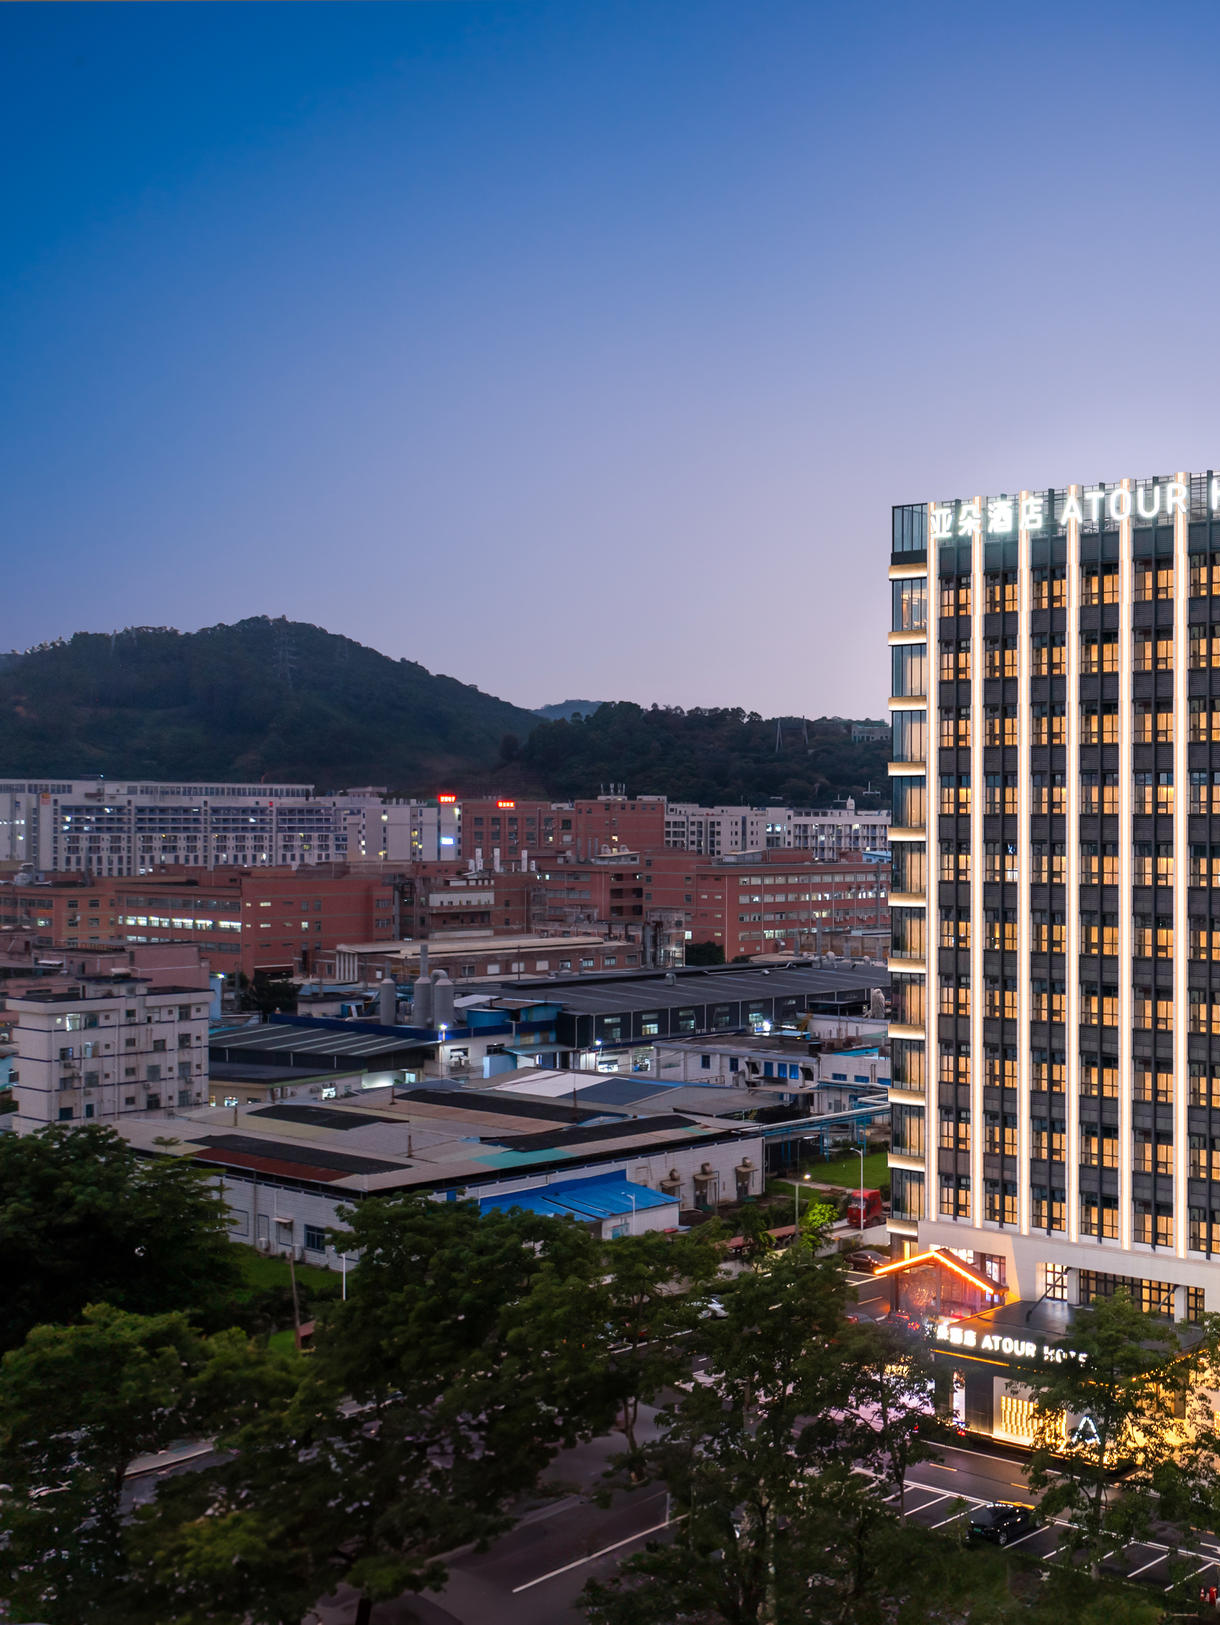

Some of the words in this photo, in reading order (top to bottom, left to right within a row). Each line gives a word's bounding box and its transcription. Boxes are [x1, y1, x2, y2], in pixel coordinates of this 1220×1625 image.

[930, 496, 1044, 538] 亚朵酒店
[1060, 481, 1188, 526] ATOUR
[981, 1334, 1037, 1358] ATOUR
